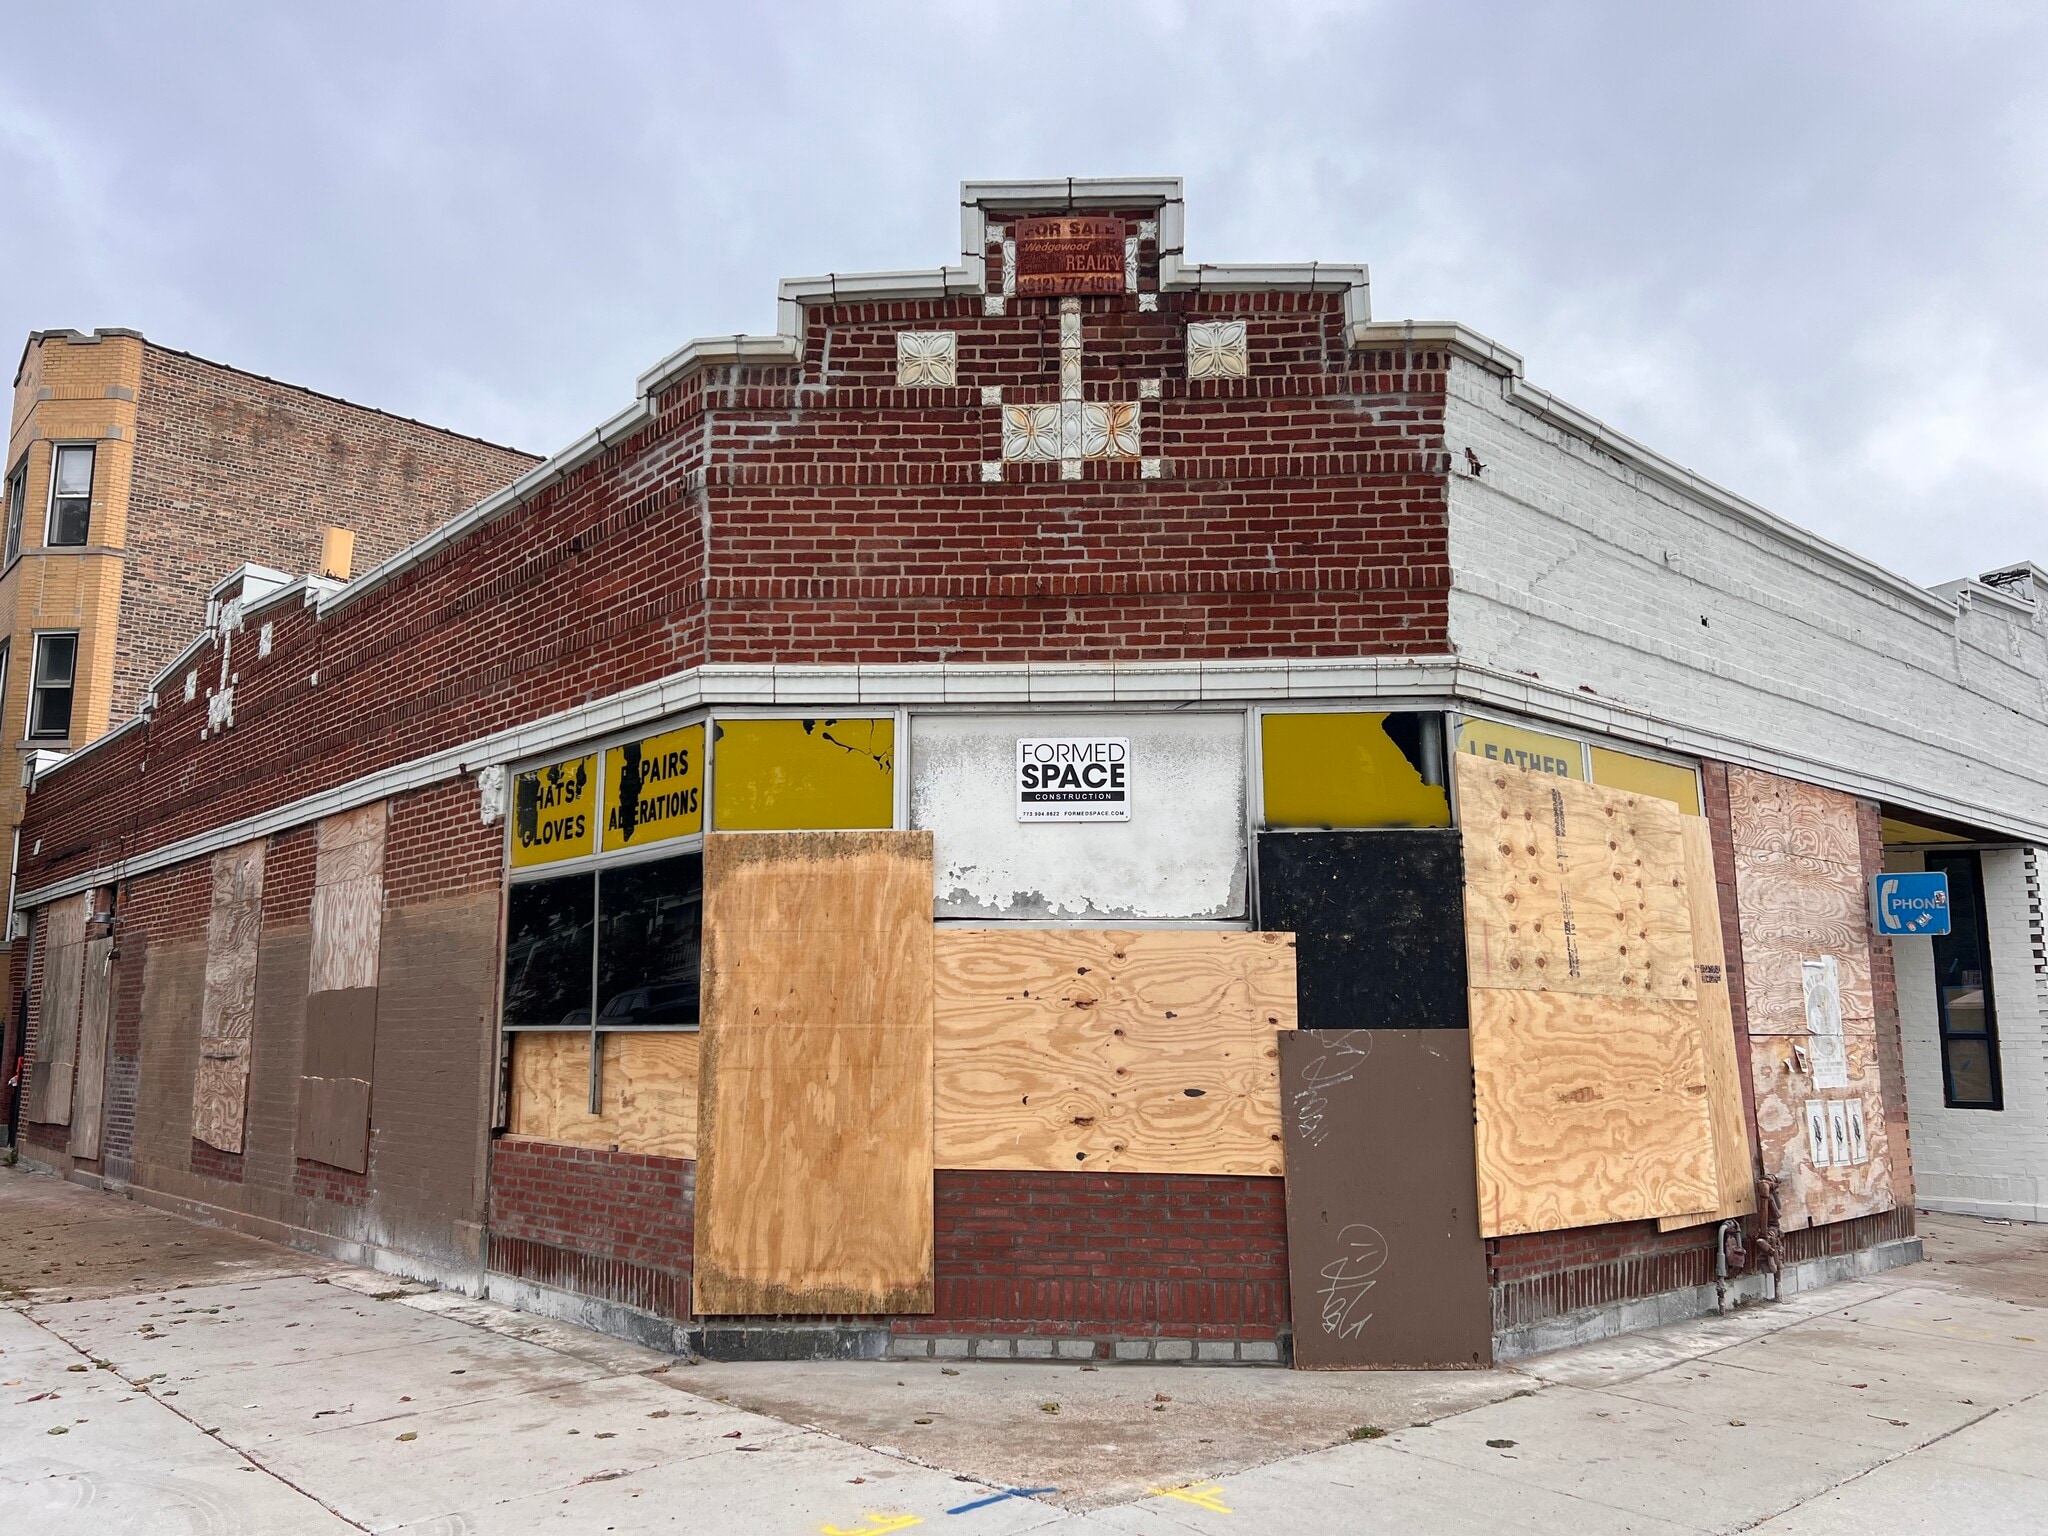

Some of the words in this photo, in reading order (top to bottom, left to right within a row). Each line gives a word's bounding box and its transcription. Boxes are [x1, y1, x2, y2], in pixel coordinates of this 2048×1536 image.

[1024, 222, 1062, 237] FOR
[1069, 222, 1116, 235] SALE
[1024, 242, 1091, 254] Wedgewood
[1066, 254, 1121, 271] REALTY
[1022, 743, 1125, 763] FORMED
[1021, 763, 1125, 789] SPACE
[535, 780, 575, 810] HATS
[1035, 793, 1112, 801] CONSTRUCTION
[608, 787, 698, 831] ALERATIONS
